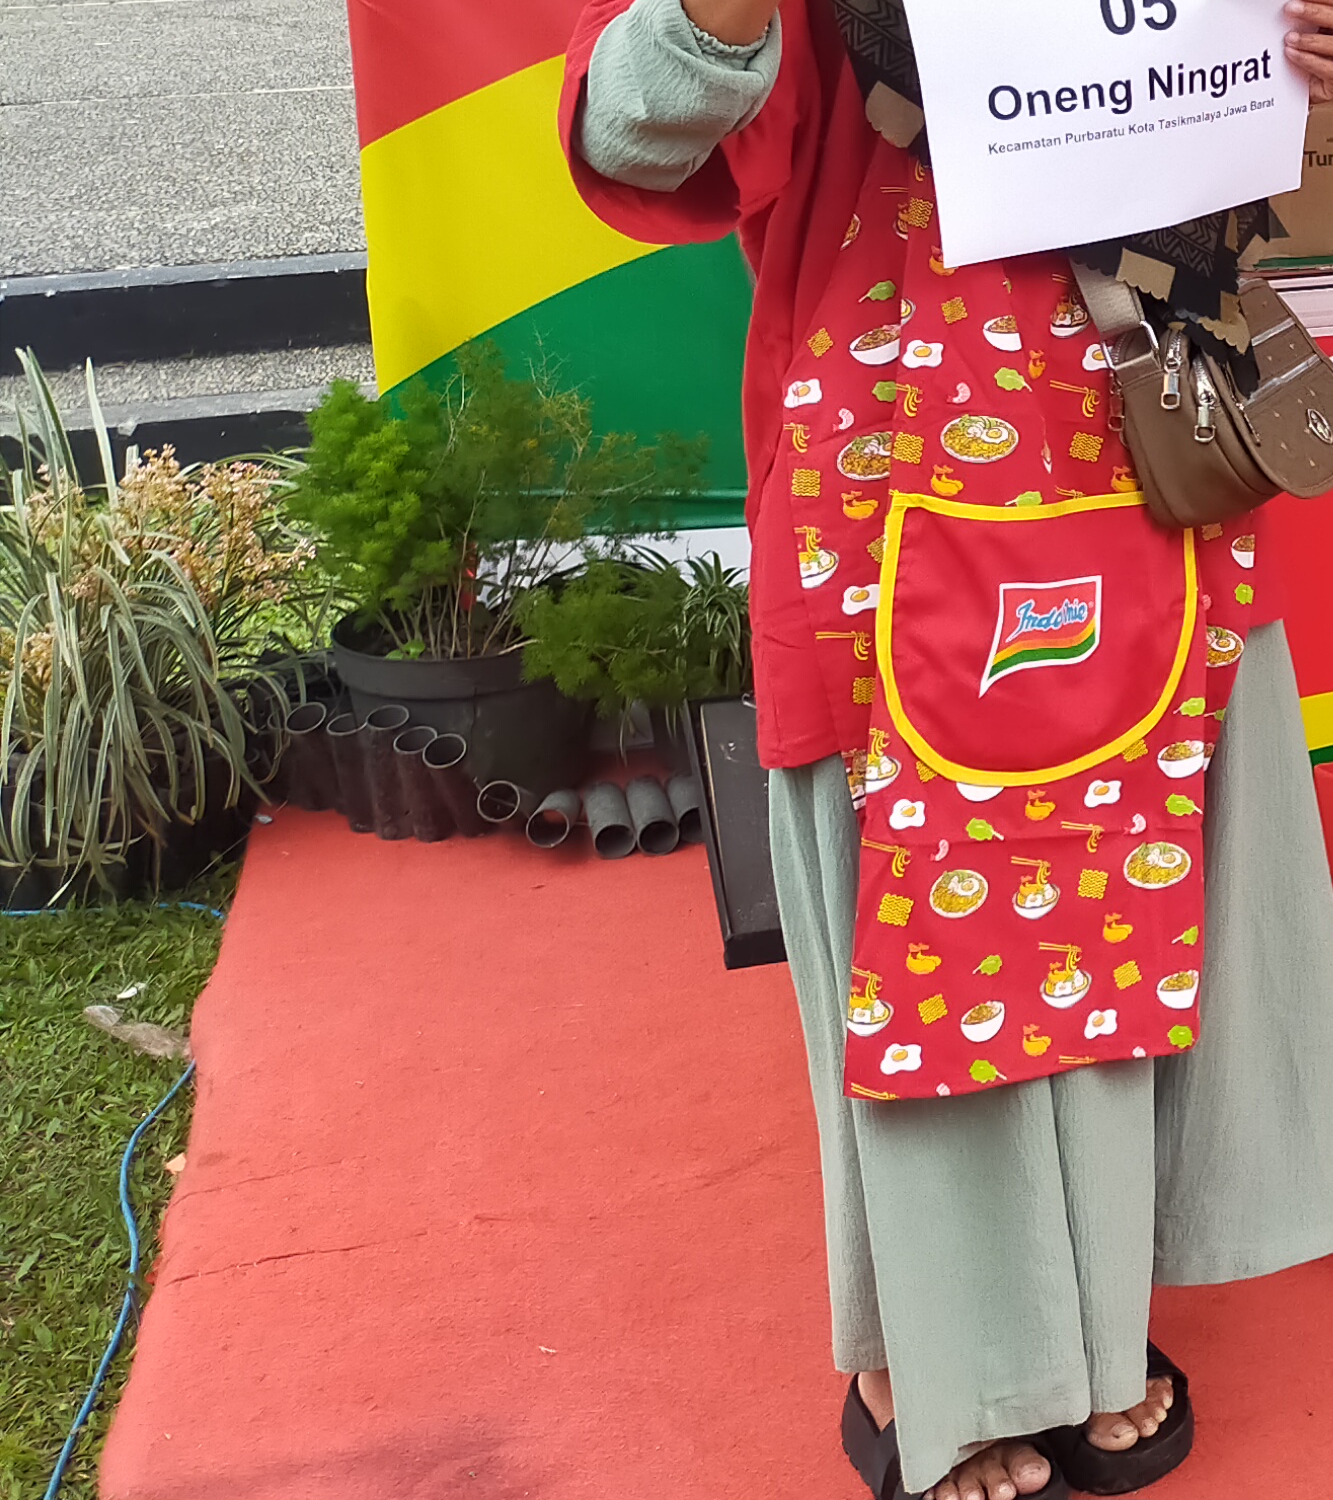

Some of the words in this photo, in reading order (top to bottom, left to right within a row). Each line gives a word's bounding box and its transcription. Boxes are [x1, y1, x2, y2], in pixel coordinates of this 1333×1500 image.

[987, 77, 1133, 121] Oneng
[1148, 48, 1272, 101] Ningrat
[988, 135, 1062, 156] Kecamatan
[1065, 124, 1125, 145] Purbaratu
[1128, 120, 1155, 136] Kota
[1158, 107, 1222, 131] Tasikmalaya
[1224, 103, 1248, 119] Jawa
[1250, 97, 1275, 113] Barat
